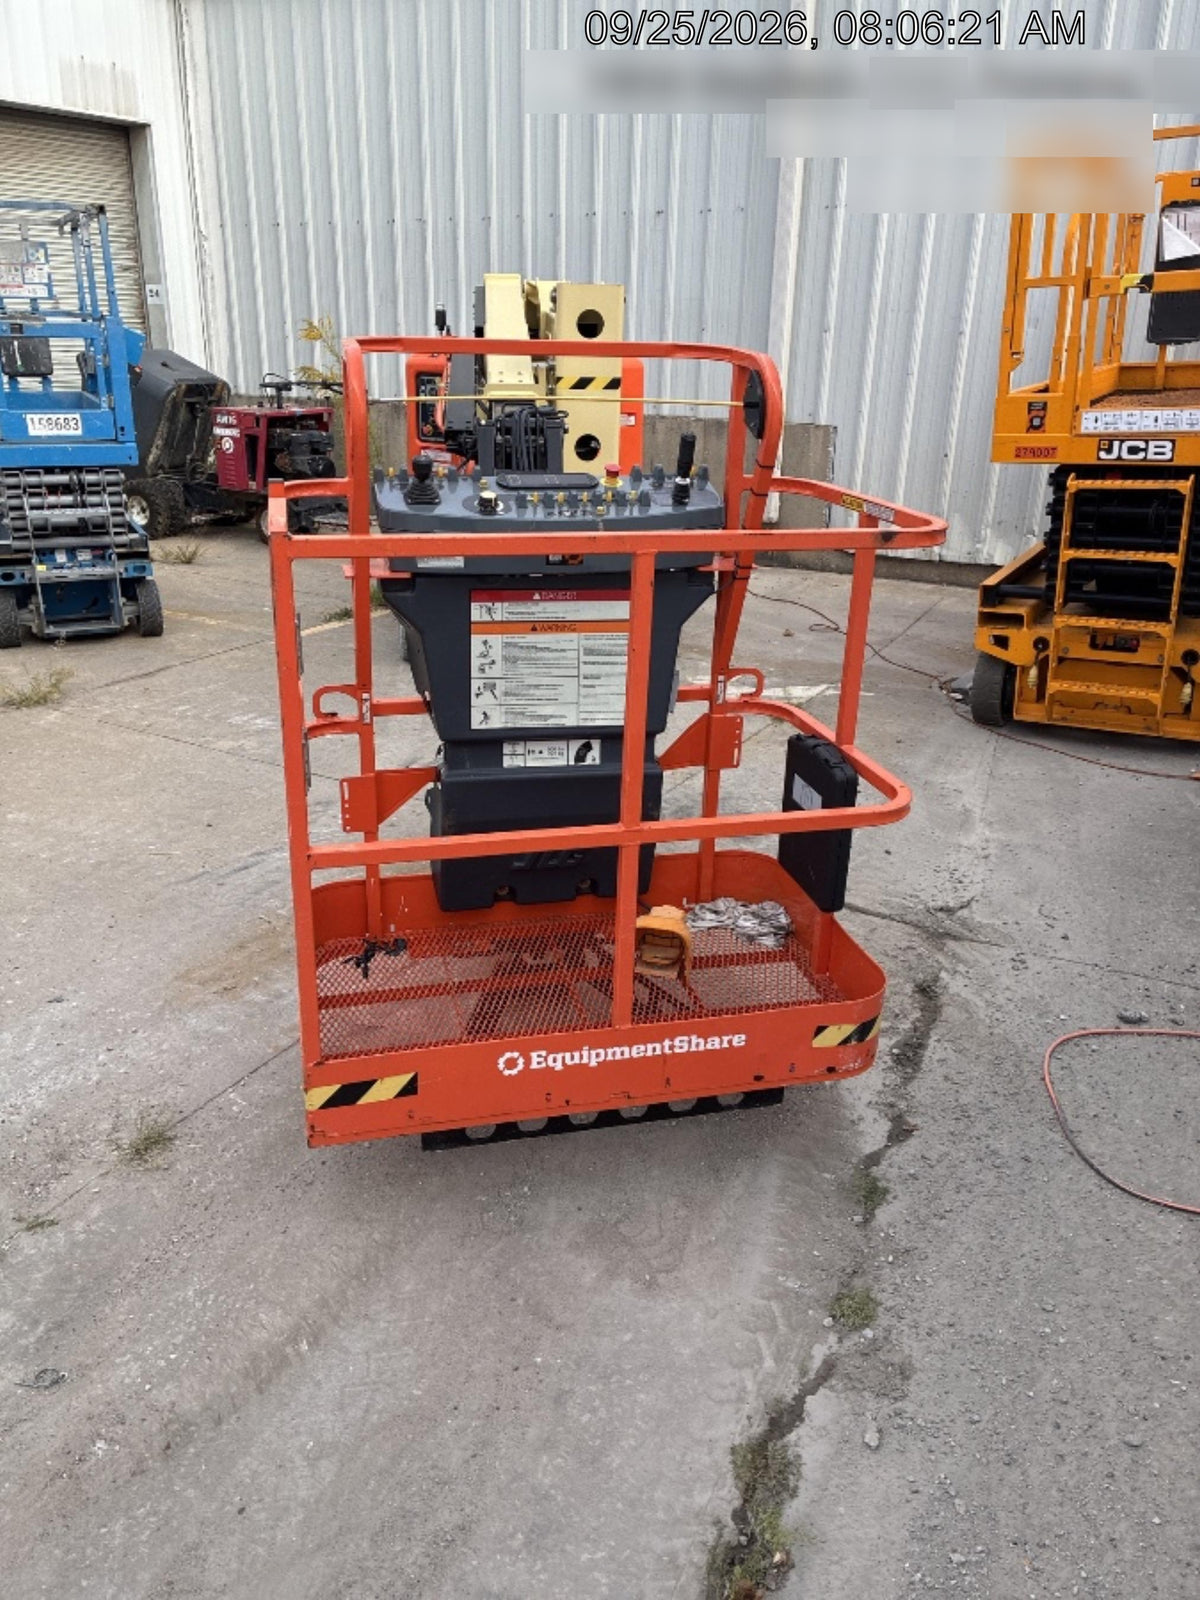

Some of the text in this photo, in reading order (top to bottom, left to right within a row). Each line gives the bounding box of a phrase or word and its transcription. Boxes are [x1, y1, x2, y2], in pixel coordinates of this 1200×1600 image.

[29, 417, 80, 431] 158683
[1098, 440, 1174, 461] JCB
[541, 591, 577, 600] DANGER
[538, 623, 577, 632] WARNING
[529, 1033, 747, 1071] EquipmentShare
